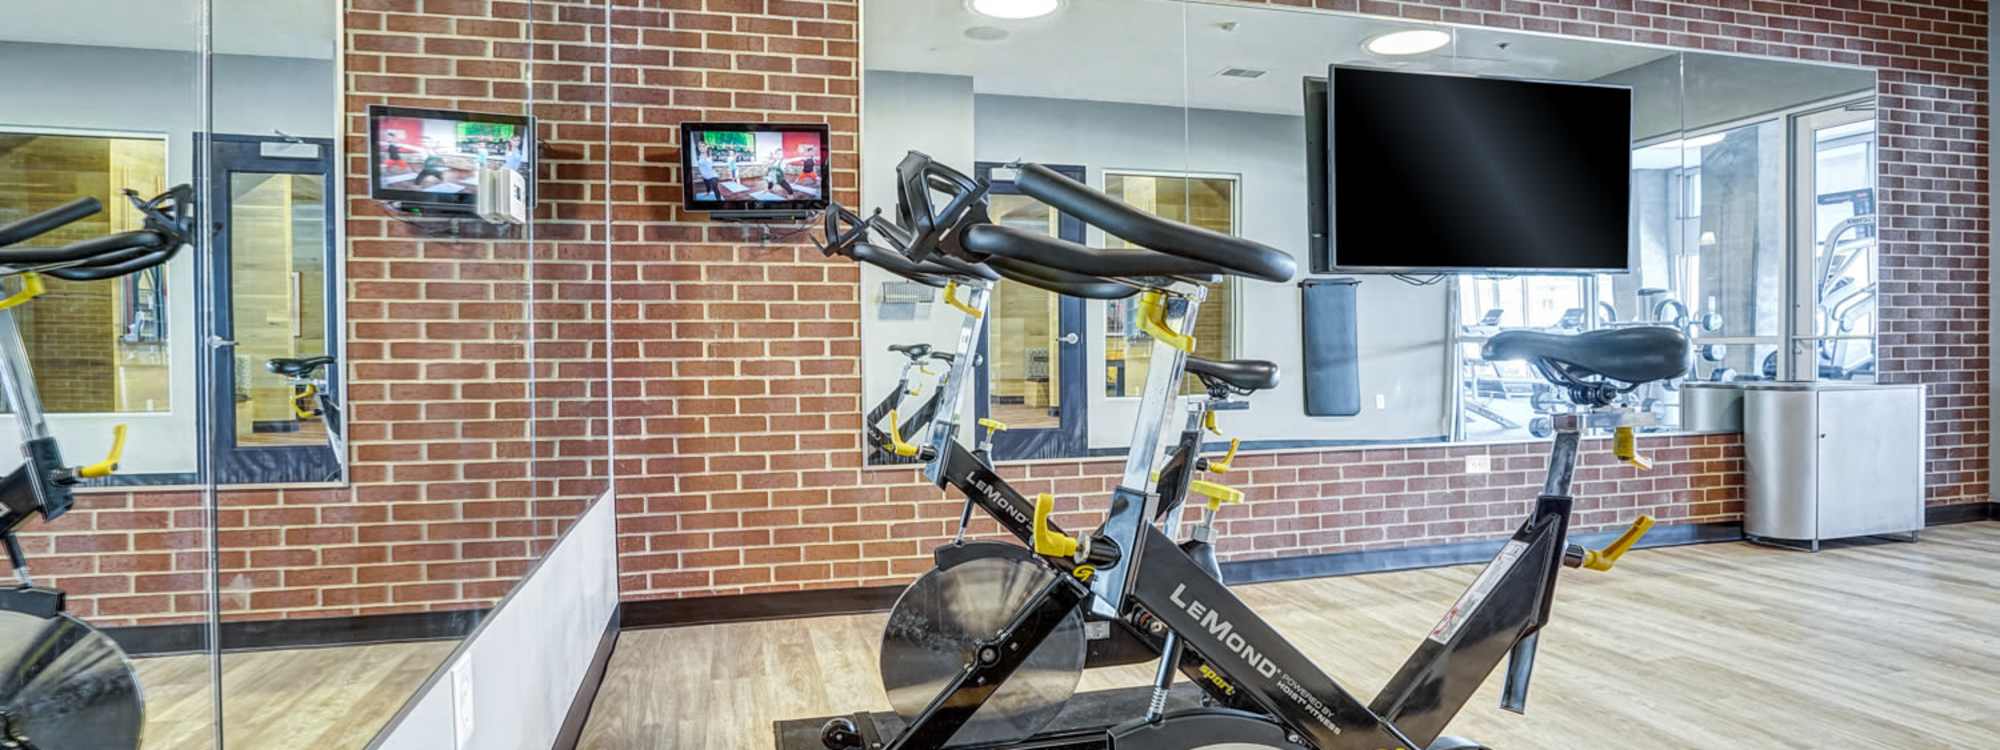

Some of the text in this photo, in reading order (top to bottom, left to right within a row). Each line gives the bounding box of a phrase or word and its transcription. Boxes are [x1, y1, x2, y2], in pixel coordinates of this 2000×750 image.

[1200, 664, 1233, 696] sport
[1282, 674, 1335, 718] POWERED BY
[1305, 703, 1342, 736] FITNESS
